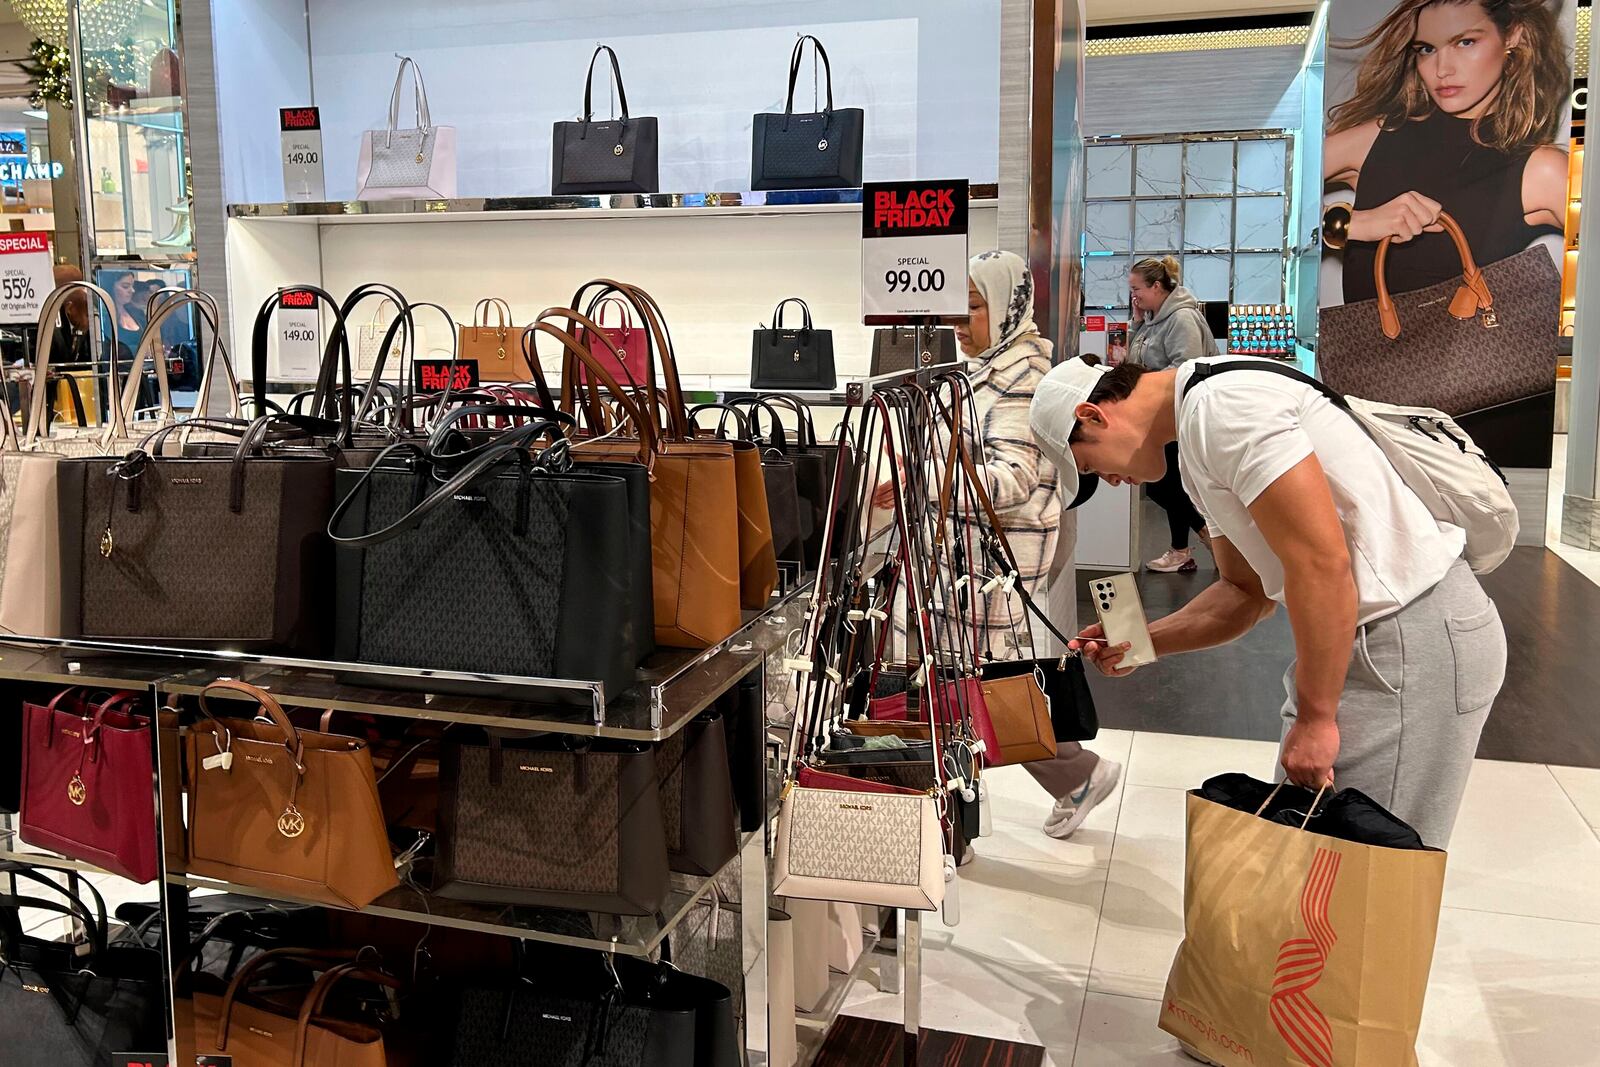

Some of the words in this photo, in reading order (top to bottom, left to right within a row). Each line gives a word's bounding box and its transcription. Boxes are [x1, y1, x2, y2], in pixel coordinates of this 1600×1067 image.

[285, 110, 315, 120] BLACK
[285, 118, 315, 127] FRIDAY
[287, 152, 319, 165] 149.00
[0, 161, 64, 180] CHAMP
[874, 189, 955, 209] BLACK
[874, 208, 955, 228] FRIDAY
[0, 236, 45, 251] SPECIAL
[897, 257, 930, 266] SPECIAL
[885, 268, 945, 293] 99.00
[2, 277, 35, 300] 55%
[282, 296, 313, 306] FRIDAY
[283, 329, 315, 341] 149.00
[421, 365, 470, 378] BLACK
